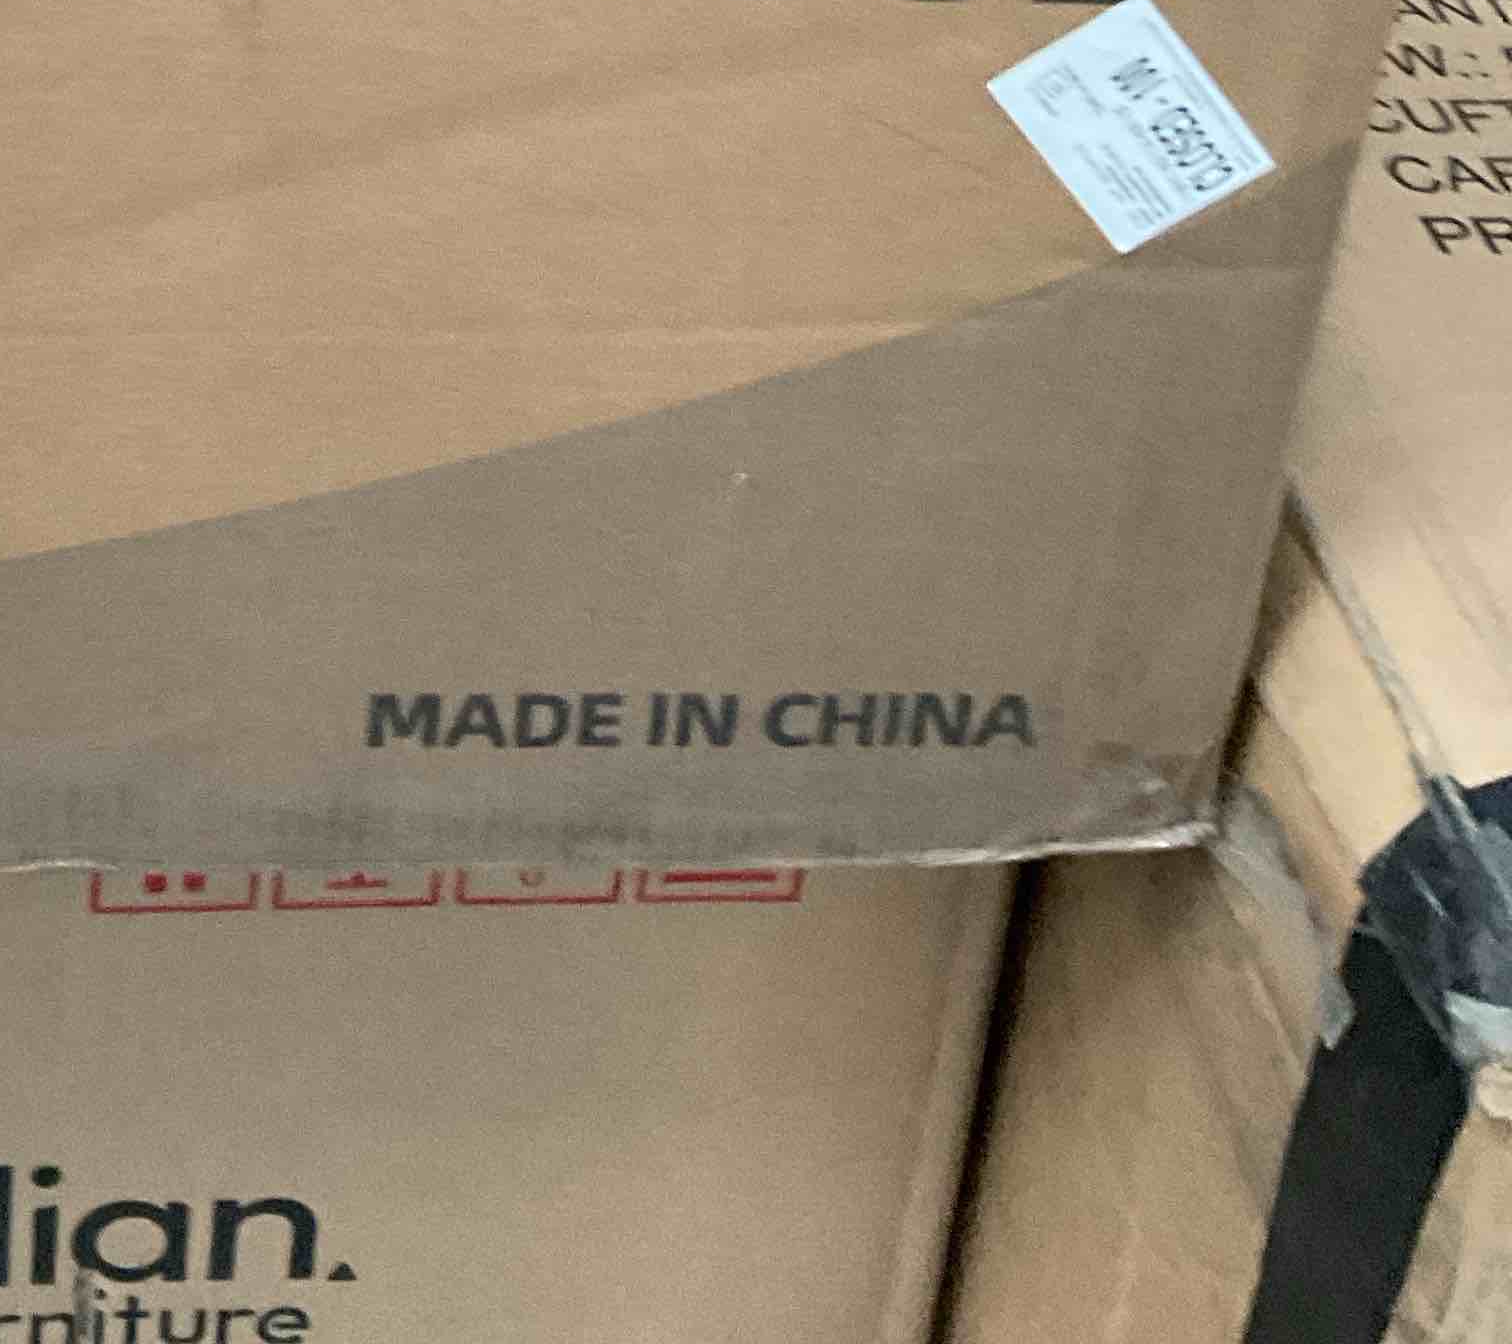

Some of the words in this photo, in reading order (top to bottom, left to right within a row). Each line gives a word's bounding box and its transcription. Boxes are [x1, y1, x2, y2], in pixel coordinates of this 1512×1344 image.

[367, 690, 623, 749] MADE
[646, 690, 741, 749] IN
[763, 690, 1037, 750] CHINA
